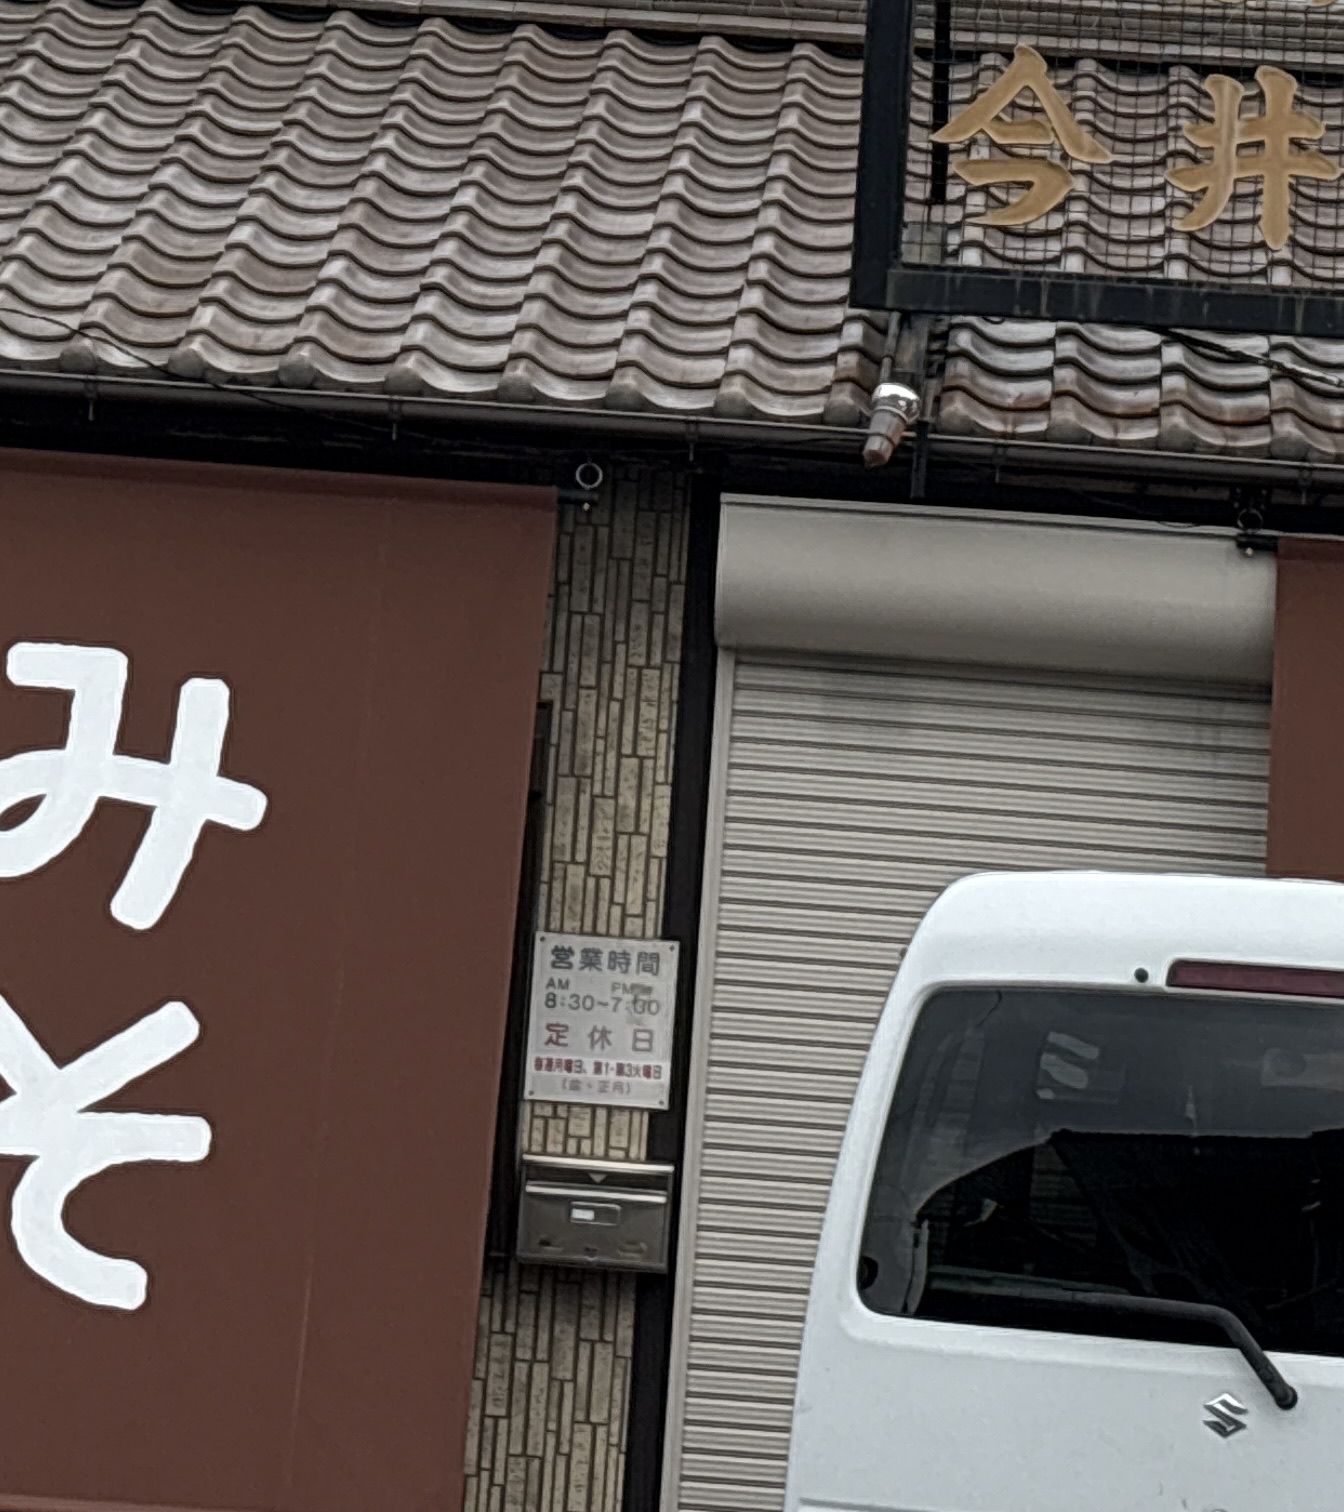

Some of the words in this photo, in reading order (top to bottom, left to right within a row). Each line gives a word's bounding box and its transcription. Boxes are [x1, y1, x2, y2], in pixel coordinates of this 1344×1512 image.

[551, 945, 660, 976] 営業時間
[545, 977, 570, 990] AM
[544, 1022, 654, 1053] 定休日
